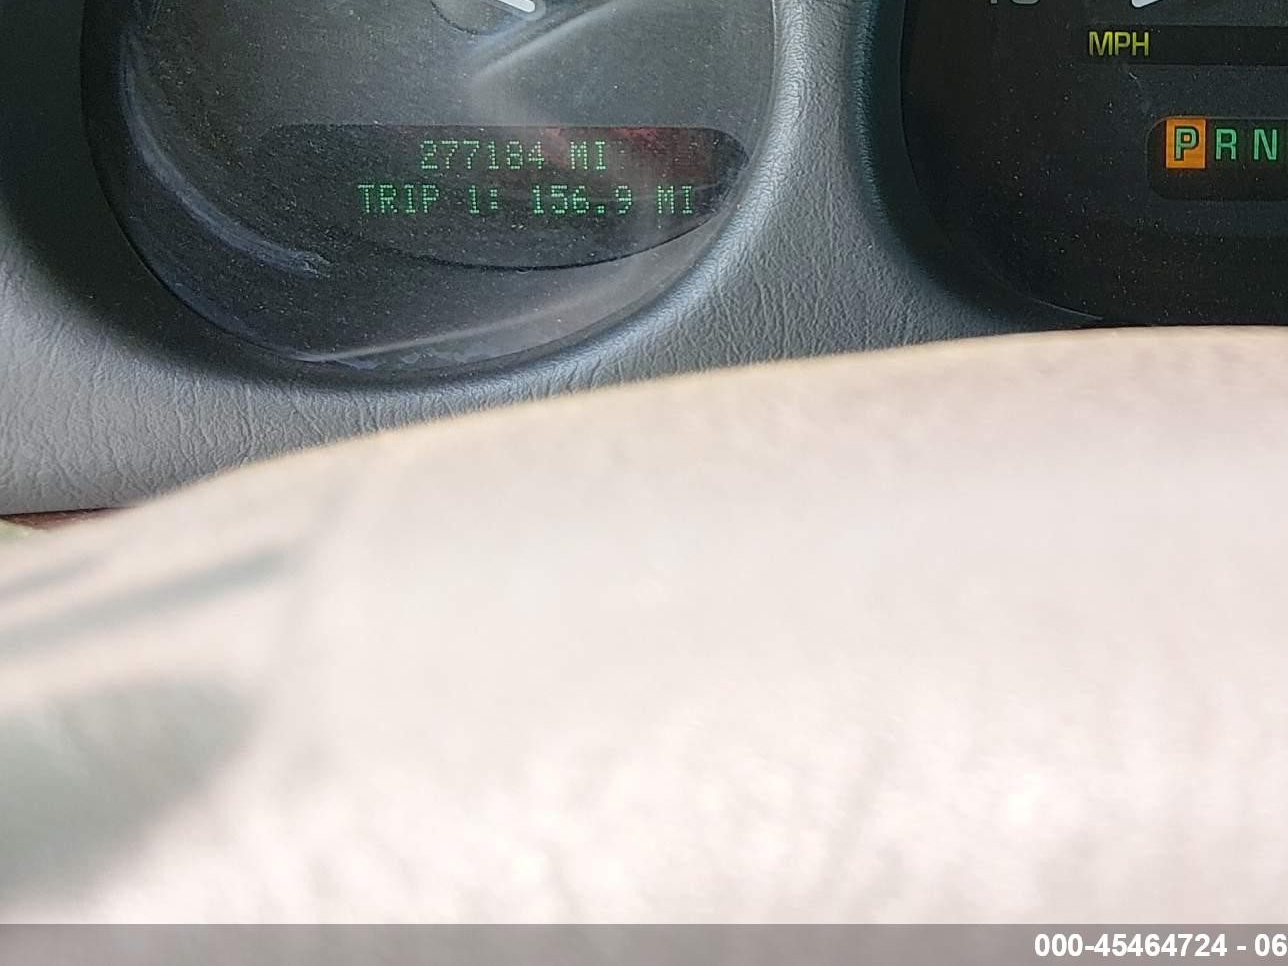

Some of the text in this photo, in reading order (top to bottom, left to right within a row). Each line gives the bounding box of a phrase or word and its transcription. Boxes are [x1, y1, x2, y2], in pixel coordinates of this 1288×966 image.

[1089, 32, 1150, 56] MPH
[419, 139, 608, 170] 277184 MI
[1174, 128, 1197, 159] P
[1214, 129, 1237, 161] R
[1253, 129, 1278, 161] N
[357, 183, 694, 214] TRIP 1: 156.9 MI
